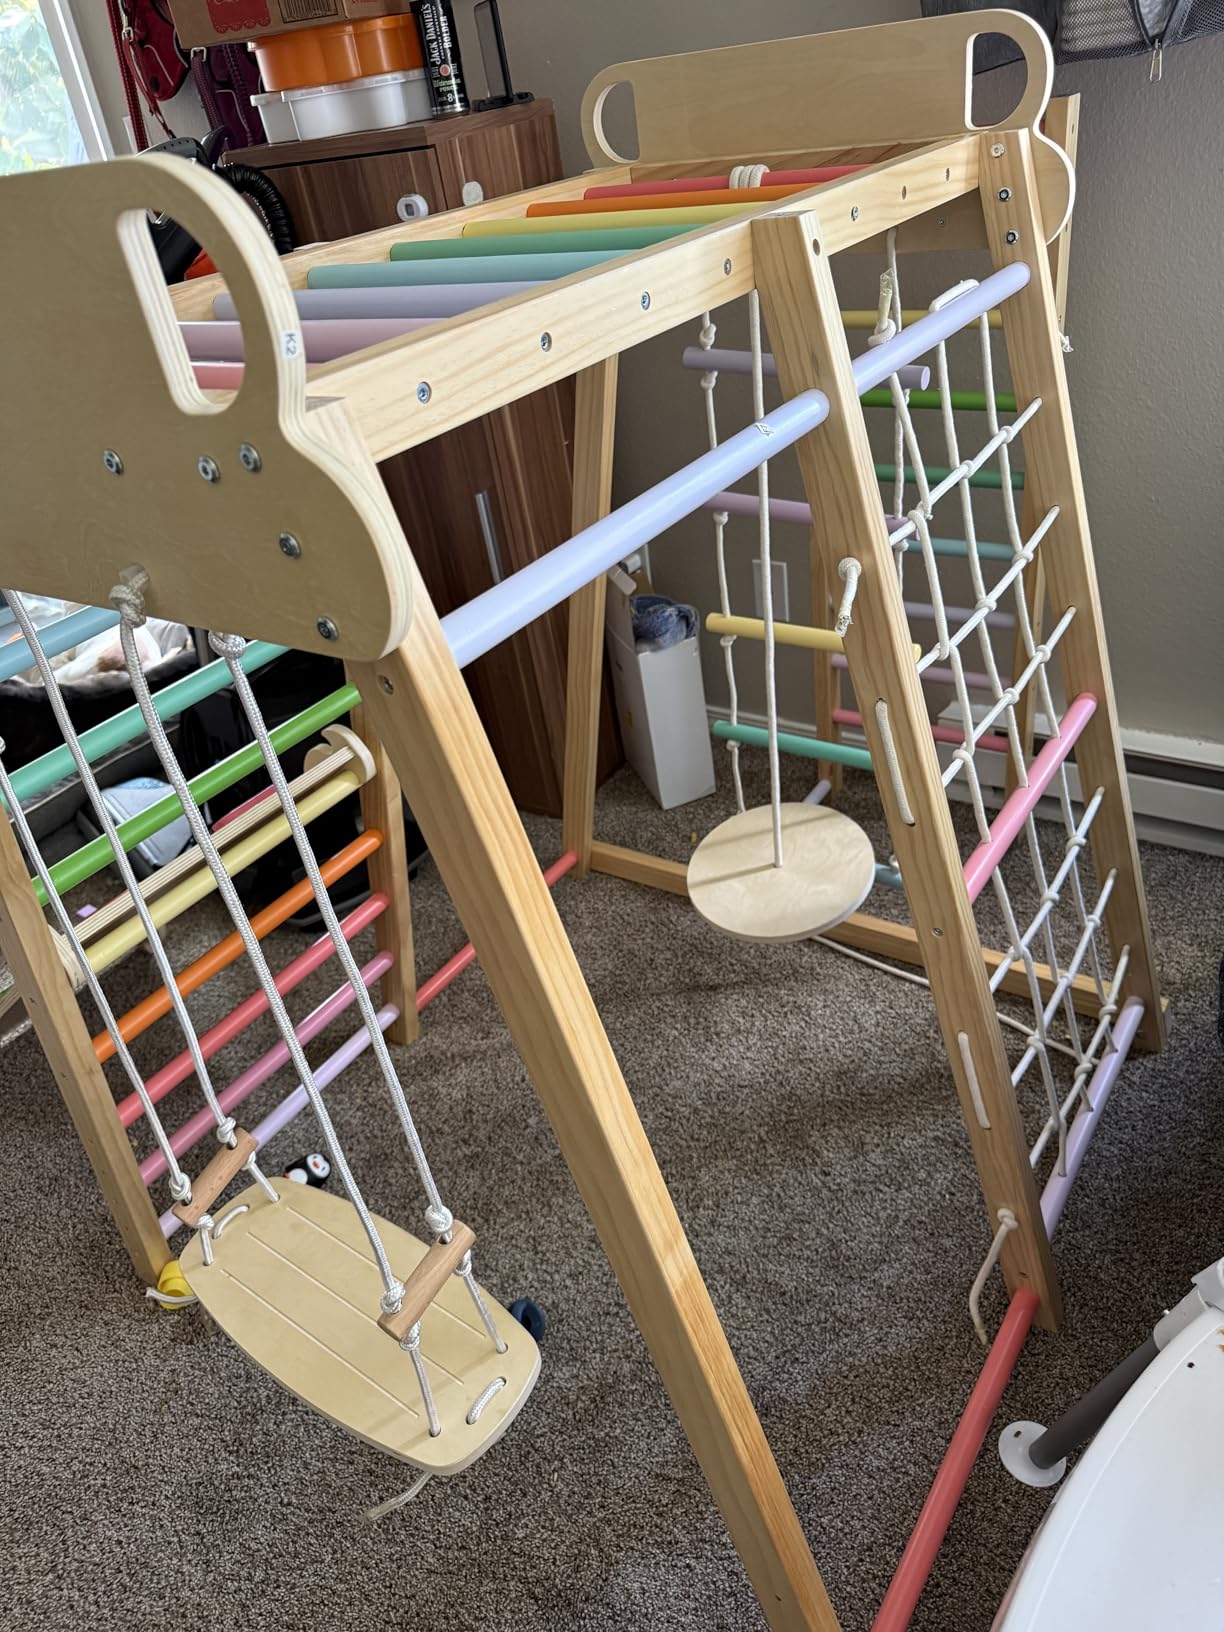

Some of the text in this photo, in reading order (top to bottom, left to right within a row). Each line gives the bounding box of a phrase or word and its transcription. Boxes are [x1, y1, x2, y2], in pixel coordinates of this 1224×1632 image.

[421, 3, 436, 40] DANIEL'S
[440, 15, 452, 48] BOLDER
[430, 42, 441, 65] JACK
[285, 333, 297, 356] K2
